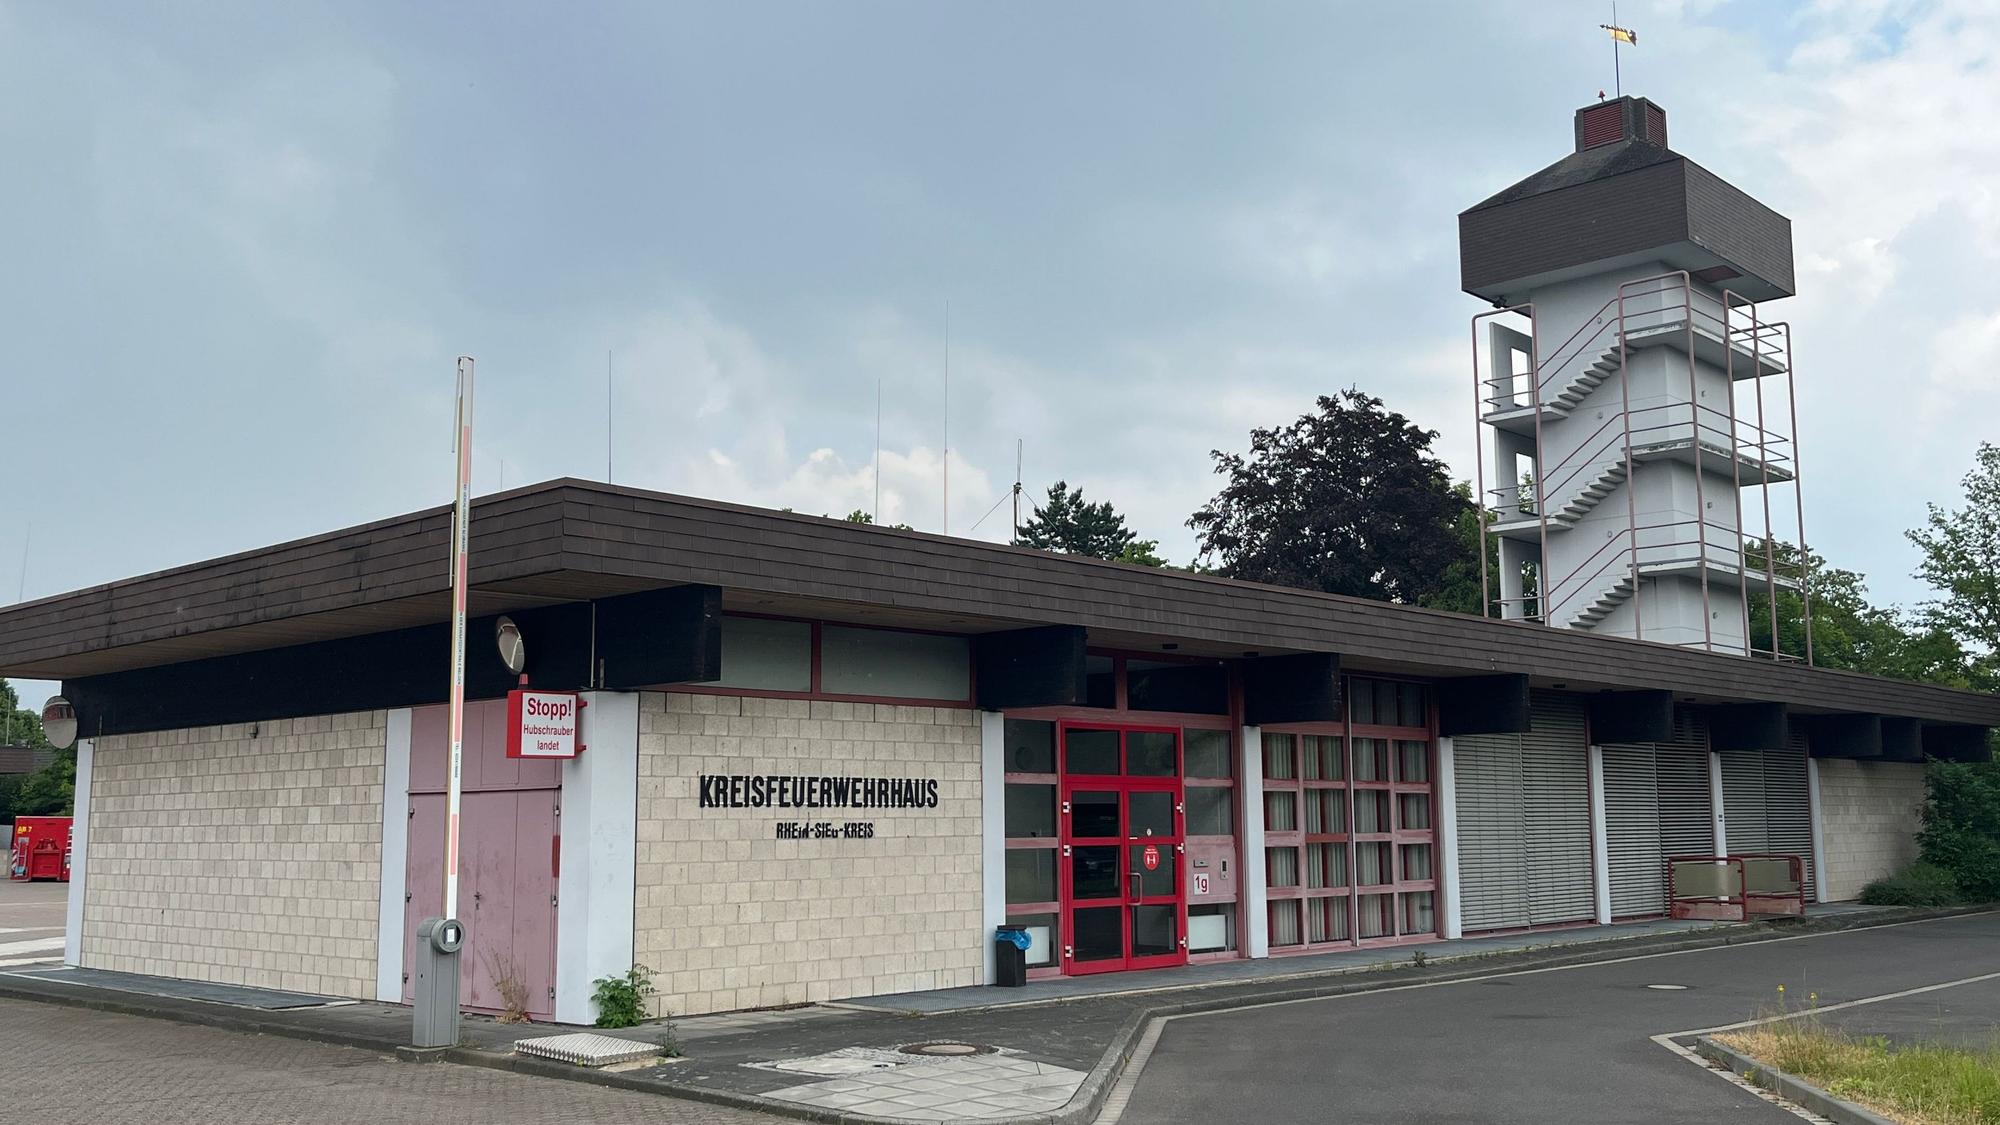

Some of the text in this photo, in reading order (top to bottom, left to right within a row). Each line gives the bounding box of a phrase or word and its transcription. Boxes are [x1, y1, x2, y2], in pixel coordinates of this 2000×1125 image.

[527, 697, 572, 720] Stopp!
[523, 724, 574, 736] Hubschrauber
[537, 740, 560, 750] landet
[699, 774, 939, 808] KREISFEUERWEHRHAUS
[1195, 875, 1208, 893] 1g
